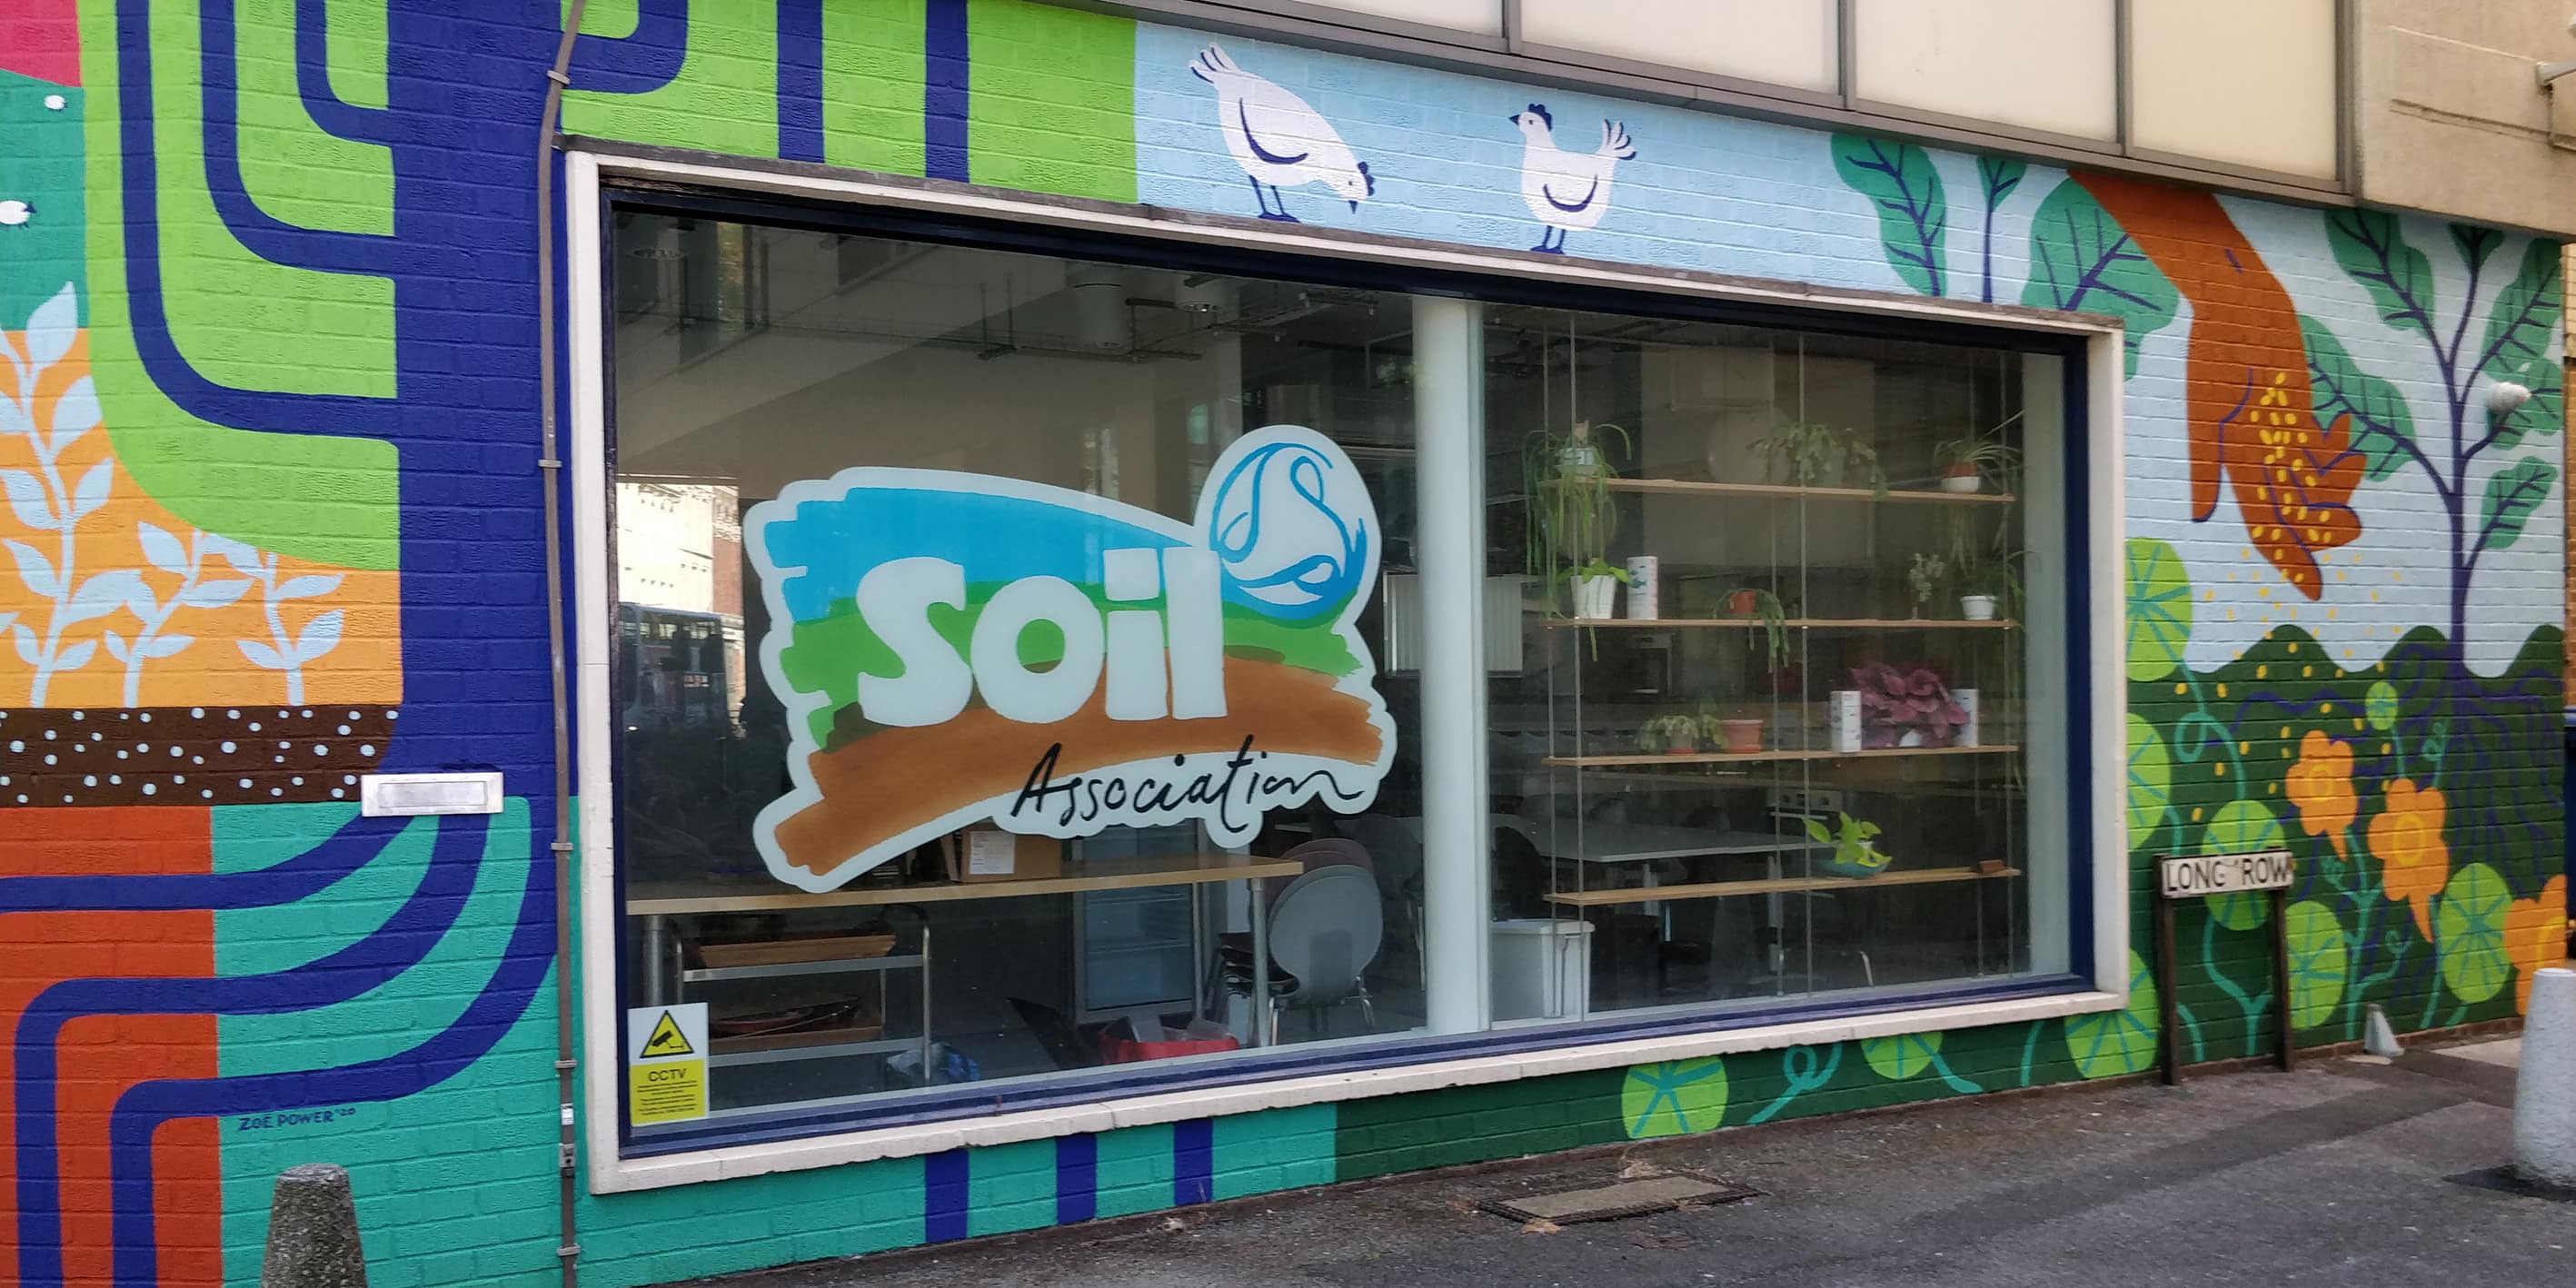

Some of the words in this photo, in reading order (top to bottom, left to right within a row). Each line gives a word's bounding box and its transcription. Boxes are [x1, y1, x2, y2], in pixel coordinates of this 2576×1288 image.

[1010, 734, 1365, 833] Association
[2166, 861, 2226, 891] LONG
[2242, 857, 2289, 886] ROW
[648, 1068, 687, 1082] CCTV
[277, 1110, 334, 1126] POWER
